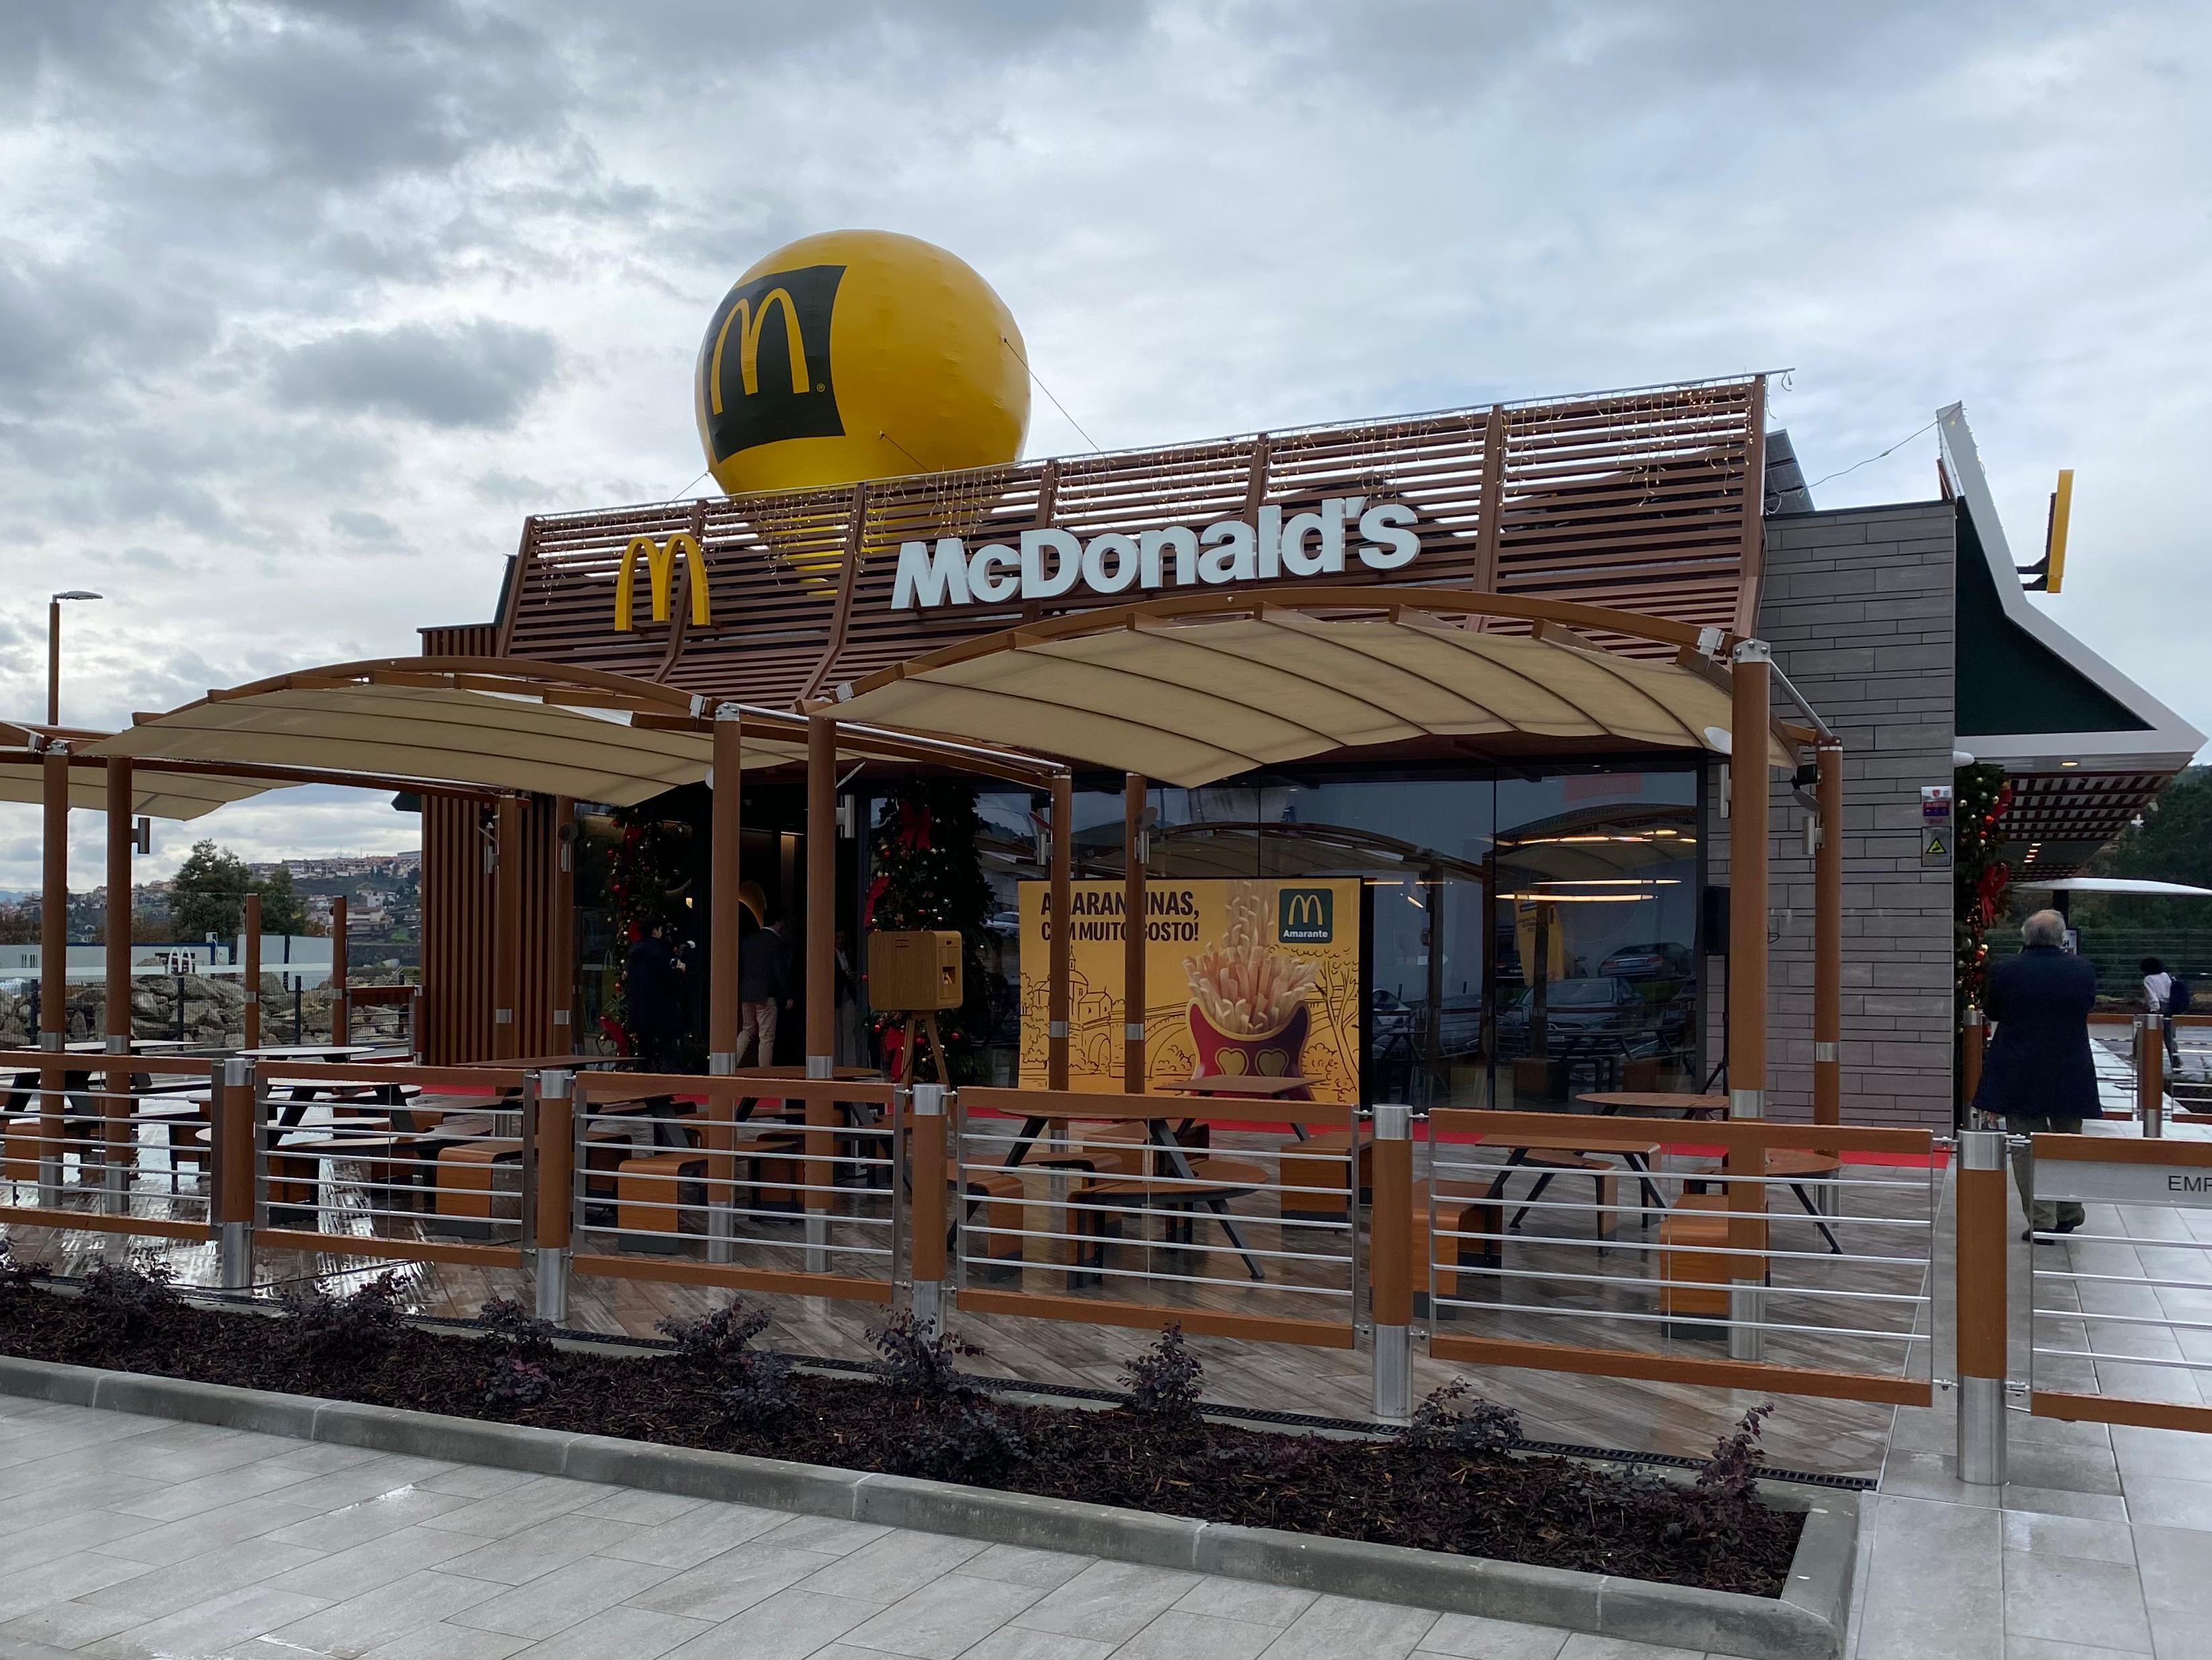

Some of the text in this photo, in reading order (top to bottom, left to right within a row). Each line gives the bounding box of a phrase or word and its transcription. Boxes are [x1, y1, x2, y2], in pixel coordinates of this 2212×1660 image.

[890, 496, 1422, 610] McDonald's
[1041, 891, 1200, 921] AARANINAS,
[1144, 922, 1199, 941] OSTO!
[1283, 929, 1329, 938] Amarante
